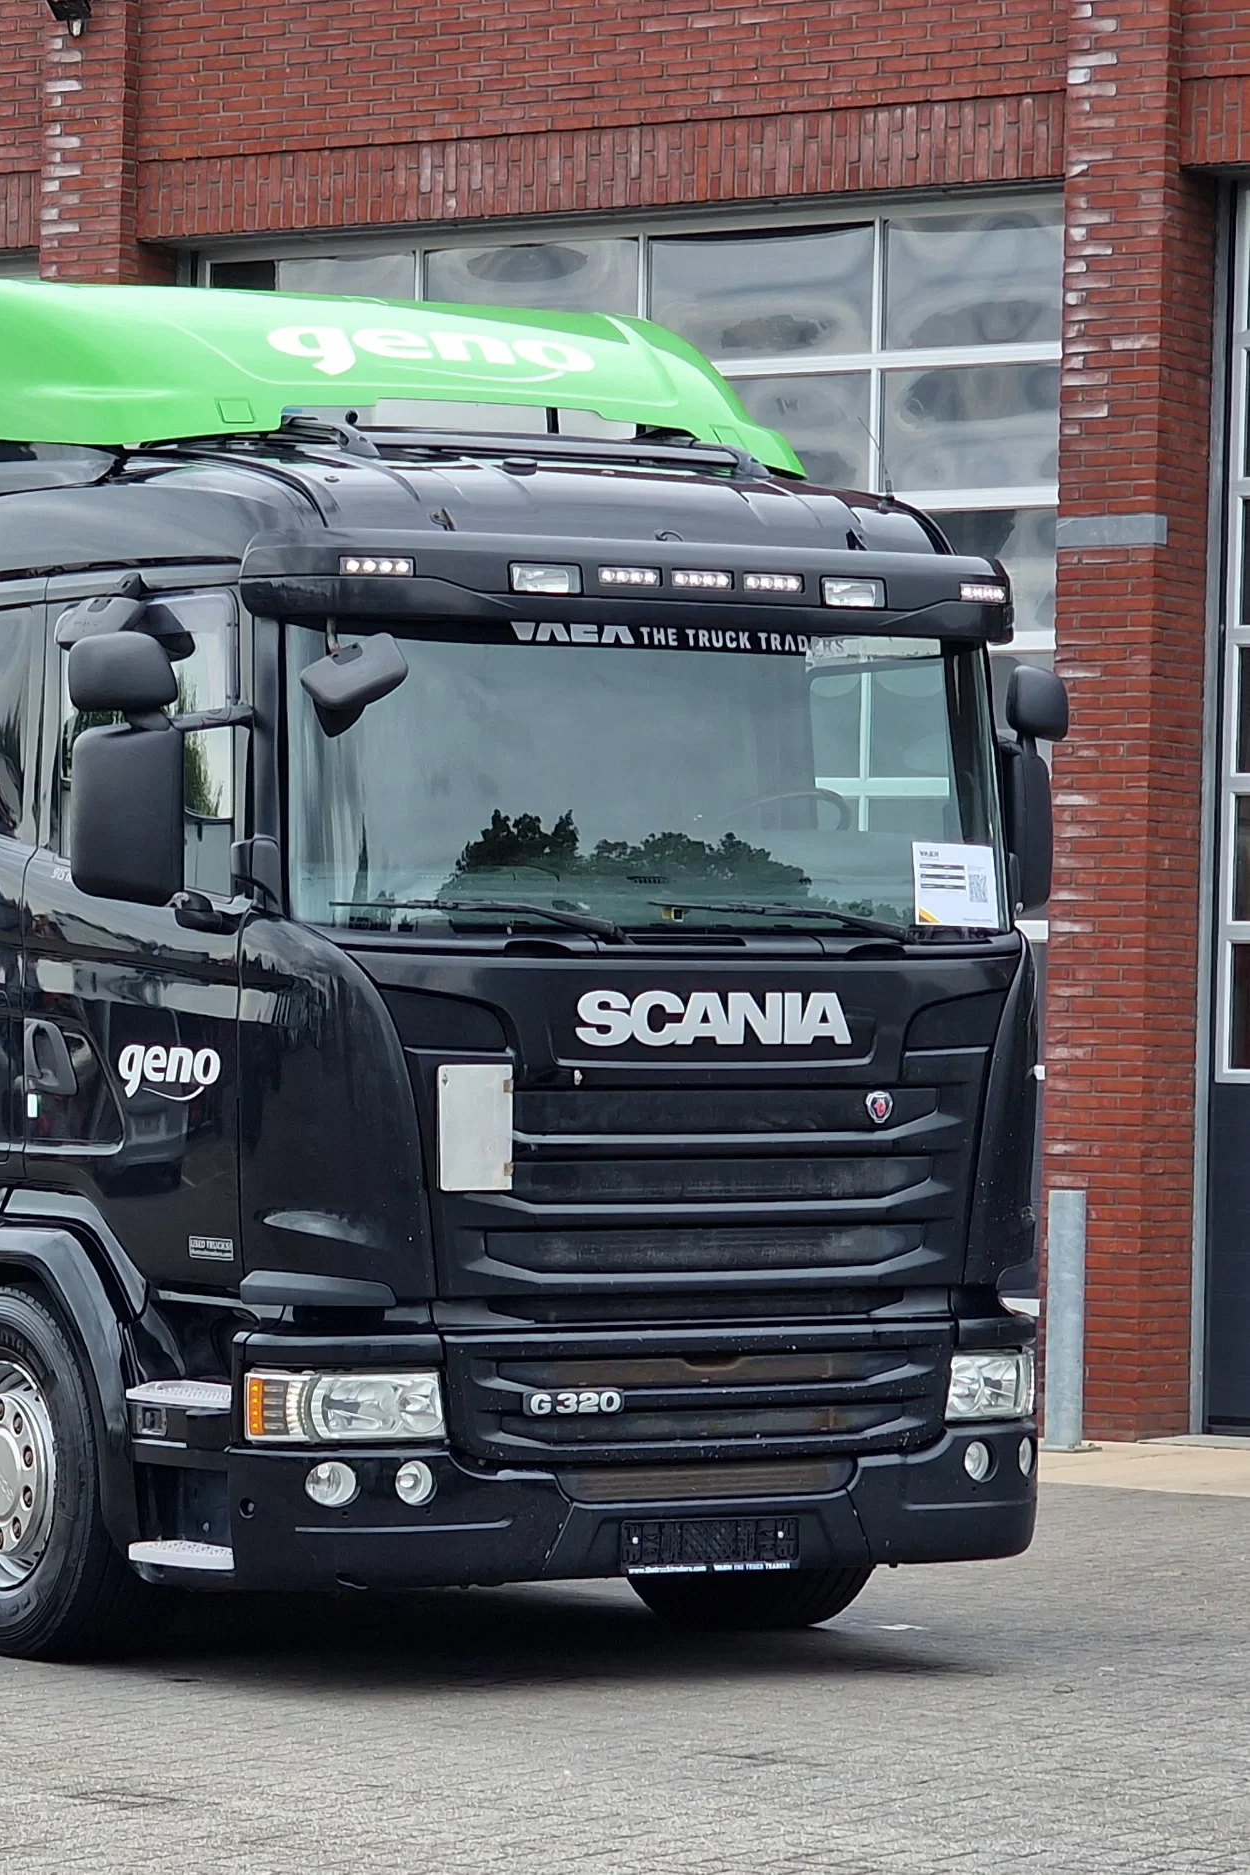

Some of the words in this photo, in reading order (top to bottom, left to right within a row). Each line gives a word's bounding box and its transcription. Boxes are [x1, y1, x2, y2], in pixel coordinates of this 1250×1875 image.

[267, 325, 595, 376] geno
[639, 626, 679, 646] THE
[685, 628, 752, 649] TRUCK
[575, 990, 852, 1047] SCANIA
[118, 1044, 221, 1098] geno
[530, 1393, 552, 1415] G
[556, 1391, 621, 1414] 320
